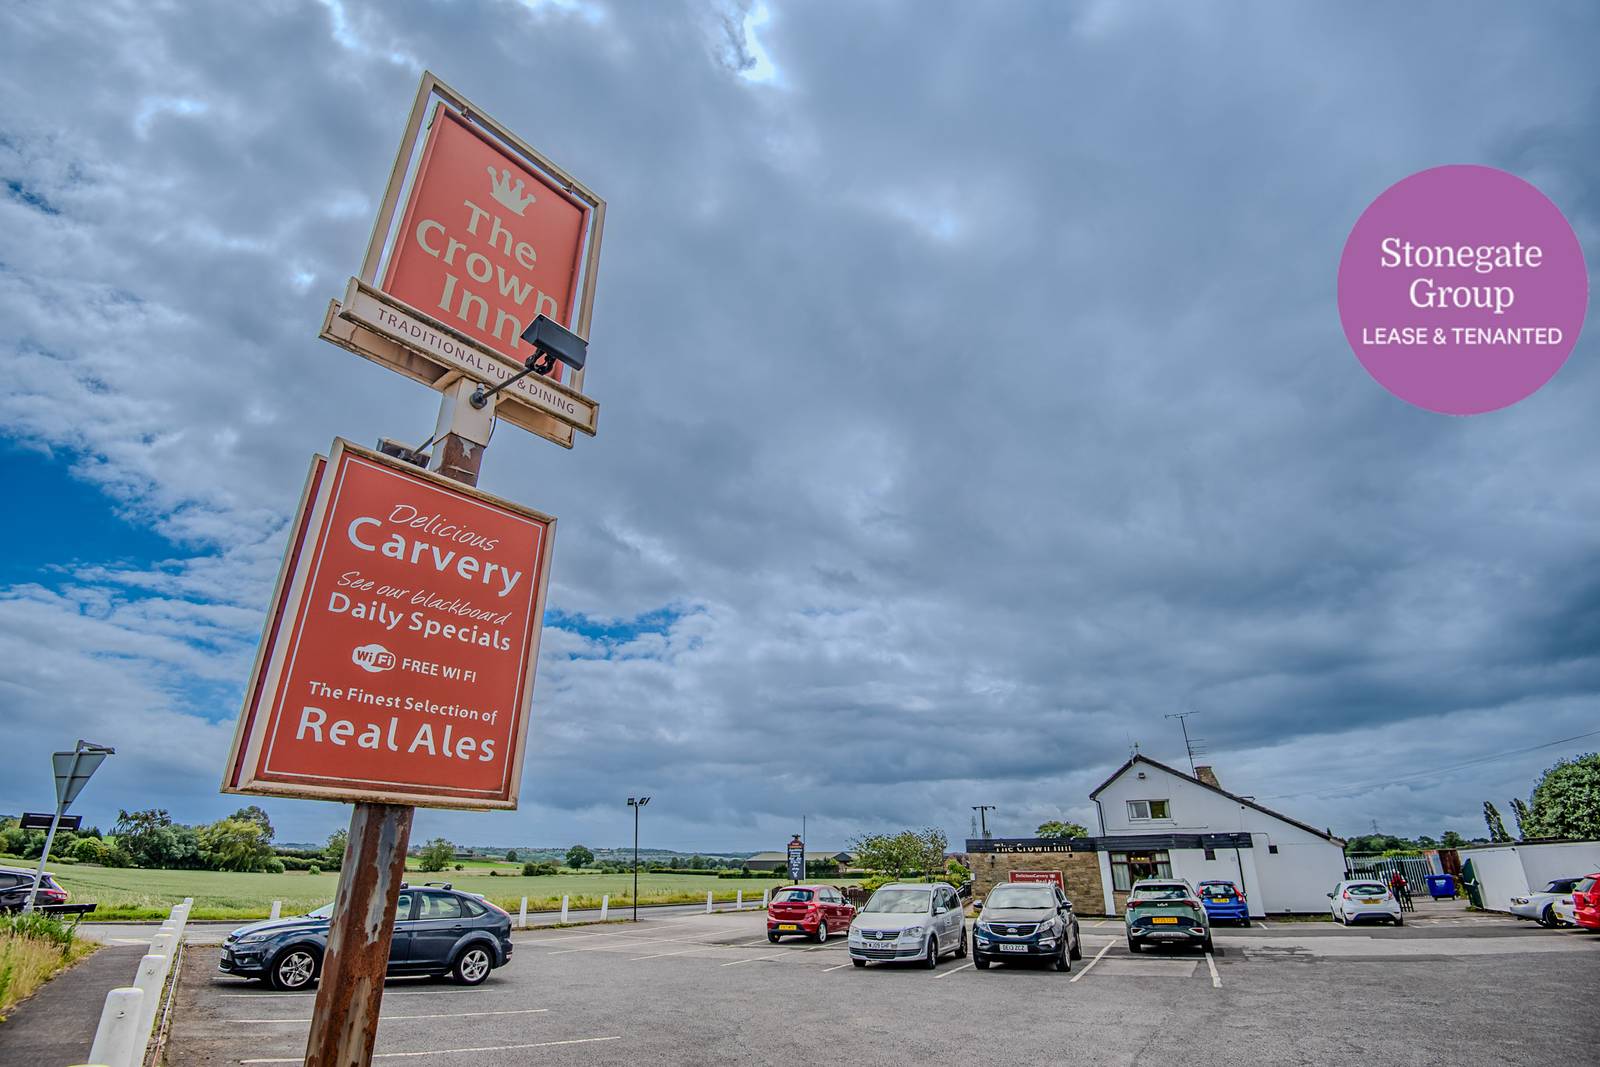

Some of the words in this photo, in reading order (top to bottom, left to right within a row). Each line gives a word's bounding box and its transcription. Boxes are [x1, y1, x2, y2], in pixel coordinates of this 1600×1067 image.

[464, 200, 537, 270] The
[415, 218, 558, 321] Crown
[437, 272, 522, 349] Inn
[377, 307, 483, 371] TRADITIONAL
[517, 378, 527, 391] &
[529, 383, 576, 415] DINING
[347, 516, 523, 597] Carvery
[388, 504, 499, 551] Delicious
[328, 591, 404, 630] Daily
[407, 611, 512, 651] Specials
[337, 571, 375, 591] See
[376, 585, 411, 599] our
[410, 589, 513, 626] blackboard
[402, 657, 439, 676] FREE
[442, 665, 461, 680] WI
[463, 670, 477, 683] FI
[309, 680, 343, 699] The
[347, 687, 400, 709] Finest
[404, 697, 479, 721] Selection
[481, 710, 498, 726] of
[296, 706, 400, 752] Real
[407, 723, 496, 762] Ales
[993, 843, 1014, 853] The
[1016, 843, 1051, 853] Crown
